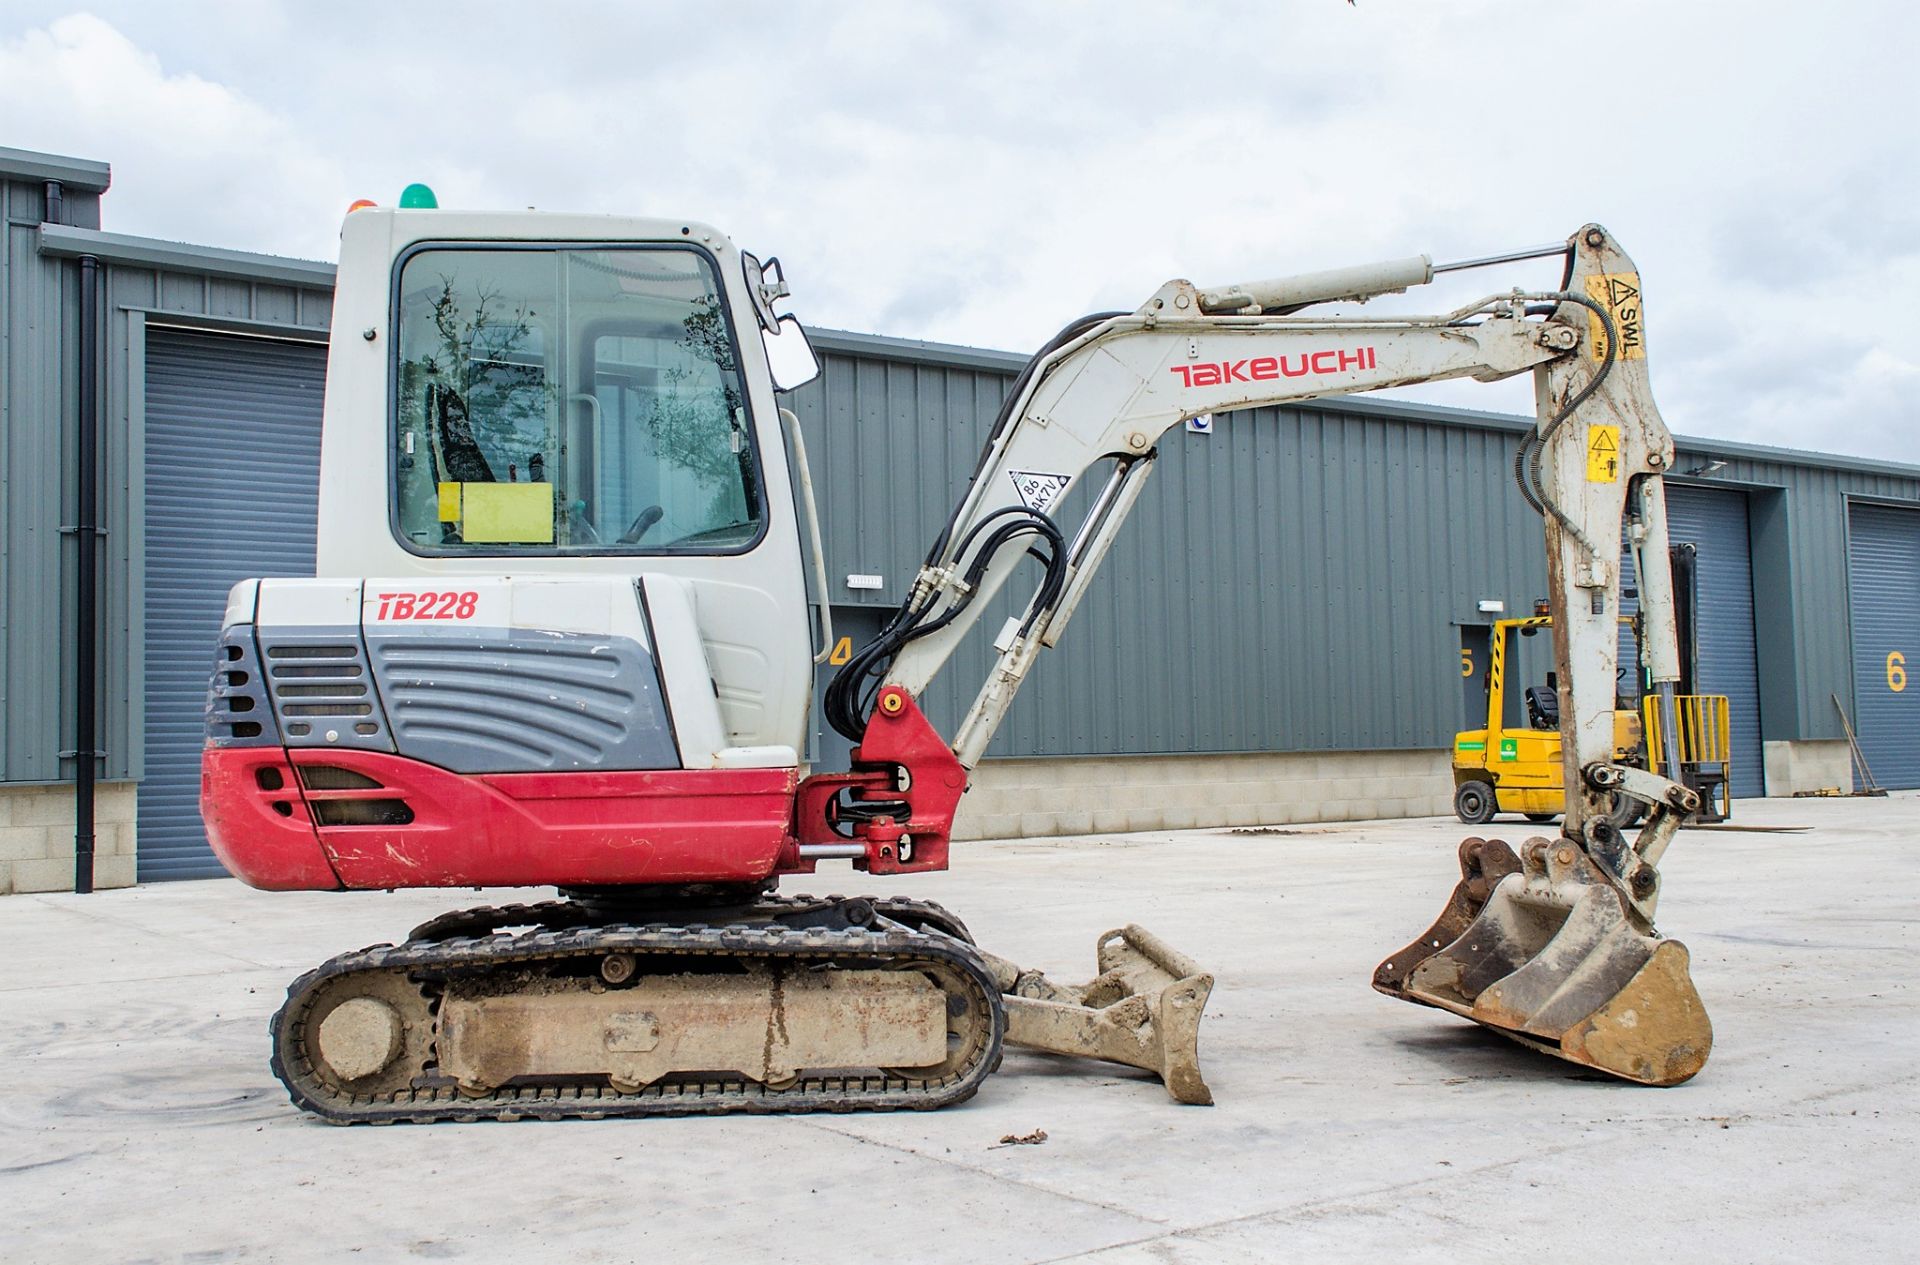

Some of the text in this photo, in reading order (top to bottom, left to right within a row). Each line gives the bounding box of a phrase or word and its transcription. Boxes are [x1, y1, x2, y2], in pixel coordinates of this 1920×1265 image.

[1620, 308, 1639, 355] SWL
[1023, 479, 1039, 495] 86
[378, 591, 479, 620] TB228
[829, 636, 852, 666] 4
[1460, 648, 1474, 678] 5
[1887, 650, 1906, 692] 6
